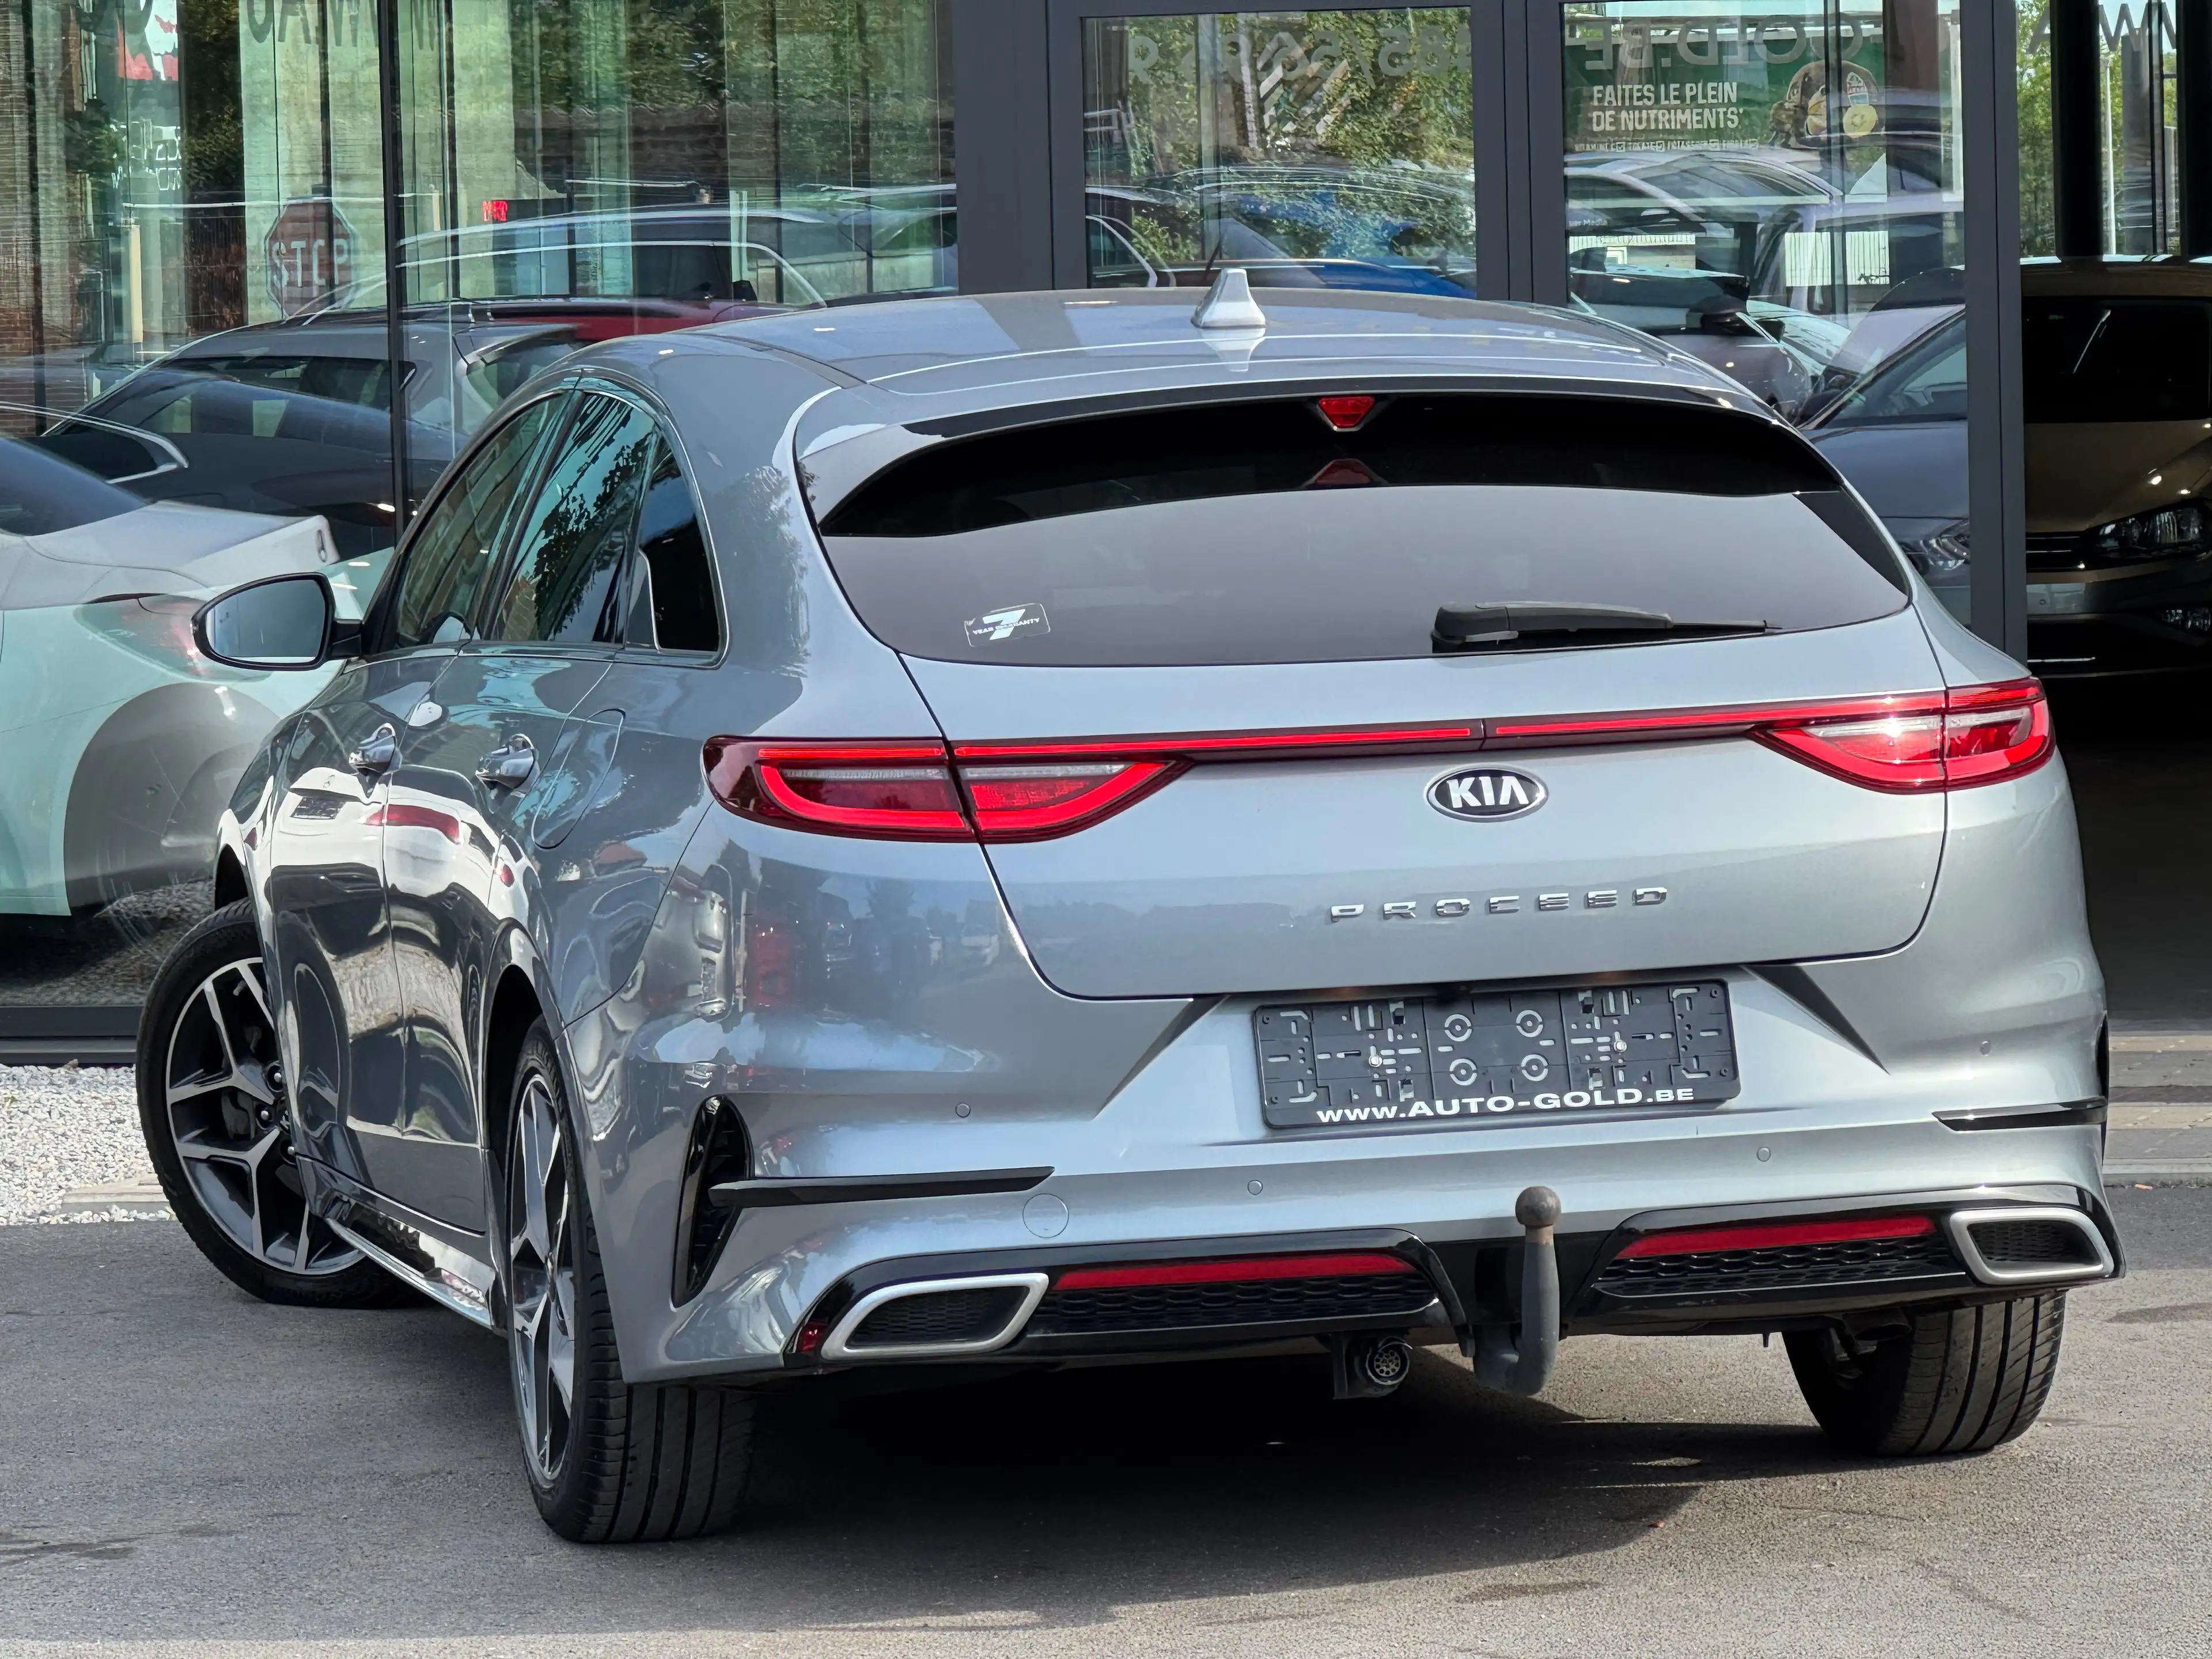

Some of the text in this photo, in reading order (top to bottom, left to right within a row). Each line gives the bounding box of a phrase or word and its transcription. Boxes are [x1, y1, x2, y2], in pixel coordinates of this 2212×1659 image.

[1592, 82, 1738, 107] FAITES LE PLEIN
[1592, 110, 1616, 132] DE
[272, 238, 348, 289] STOP
[982, 609, 1025, 641] 7
[1446, 775, 1528, 808] KIA
[1331, 887, 1668, 922] PROCEED
[1316, 1088, 1694, 1123] WWW.AUTO-GOLD.BE
